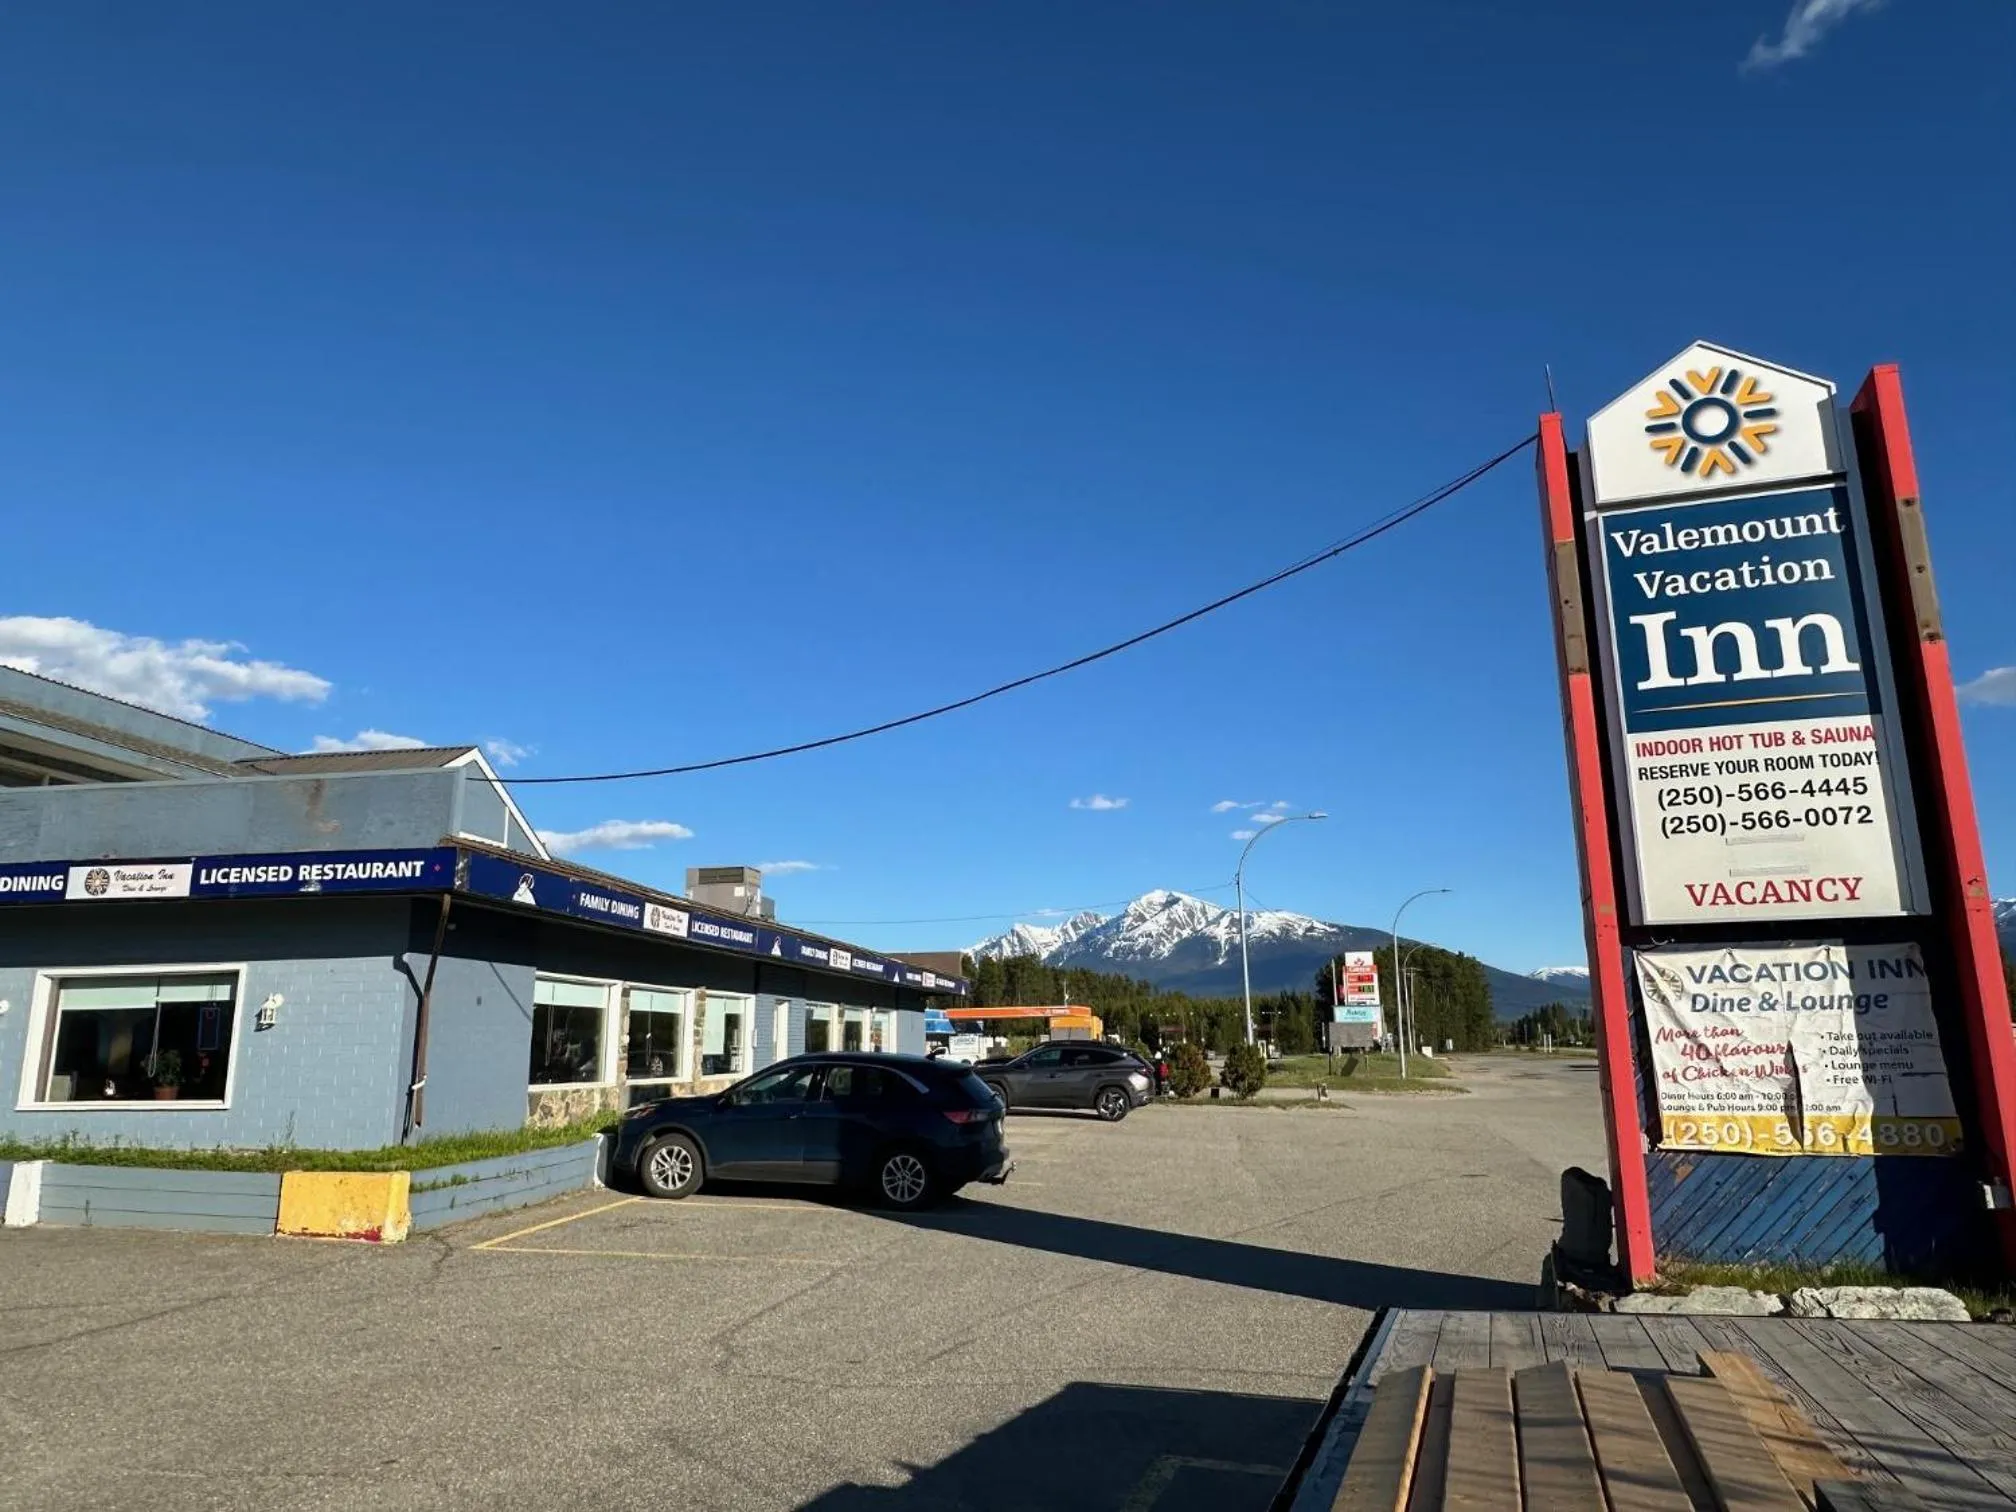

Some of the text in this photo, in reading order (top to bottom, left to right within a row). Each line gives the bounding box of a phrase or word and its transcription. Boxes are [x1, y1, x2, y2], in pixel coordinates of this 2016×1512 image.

[1610, 507, 1847, 557] Valemount
[1634, 555, 1836, 599] Vacation
[1629, 611, 1861, 691] Inn
[1635, 725, 1876, 758] INDOOR HOT TUB & SAUNA
[1638, 762, 1711, 781] RESERVE
[1714, 759, 1759, 775] YOUR
[1764, 755, 1814, 772] ROOM
[1658, 776, 1868, 811] (250)-566-4445
[1661, 805, 1873, 839] (250)-566-0072
[1, 874, 65, 892] DINING
[200, 860, 424, 885] LICENSED RESTAURANT
[1684, 876, 1863, 907] VACANCY
[580, 892, 639, 919] FAMILY DINING
[1685, 959, 1855, 985] VACATION
[1690, 990, 1888, 1015] Dine & Lounge
[1655, 1026, 1744, 1044] More than
[1826, 1031, 1854, 1041] Take
[1880, 1029, 1934, 1041] available
[1681, 1042, 1712, 1061] 40
[1829, 1045, 1859, 1057] Daily
[1832, 1060, 1914, 1071] Lounge menu
[1833, 1074, 1859, 1085] Free
